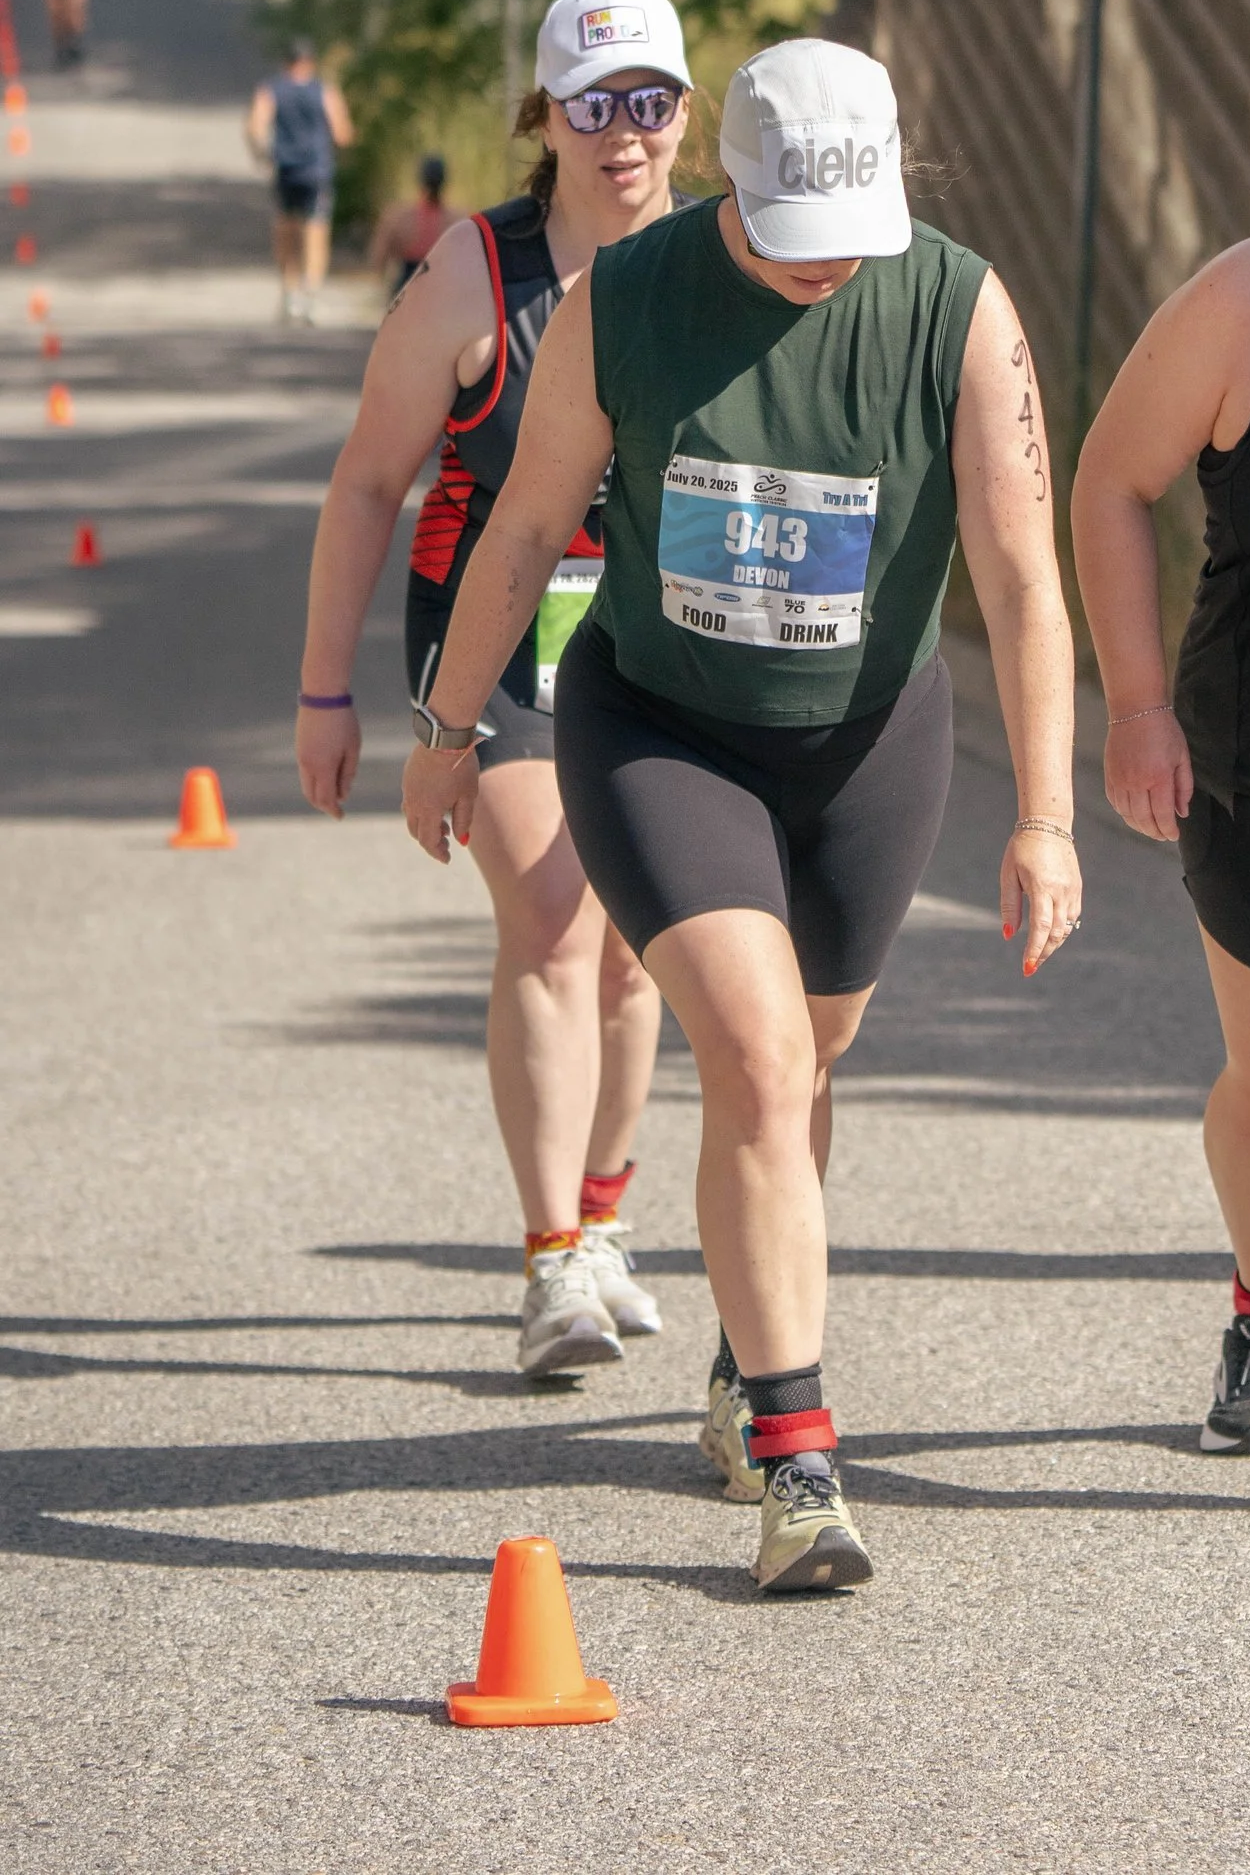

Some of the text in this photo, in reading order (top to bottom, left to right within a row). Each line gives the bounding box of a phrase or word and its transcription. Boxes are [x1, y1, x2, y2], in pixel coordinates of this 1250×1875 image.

[777, 138, 878, 191] ciele
[1011, 339, 1046, 502] 943
[667, 470, 738, 492] July 20, 2025
[823, 492, 868, 507] Try A Tri
[724, 511, 808, 562] 943
[733, 565, 790, 590] DEVON
[784, 598, 806, 606] BLUE
[785, 605, 805, 614] 70
[682, 604, 727, 633] FOOD
[780, 623, 838, 643] DRINK
